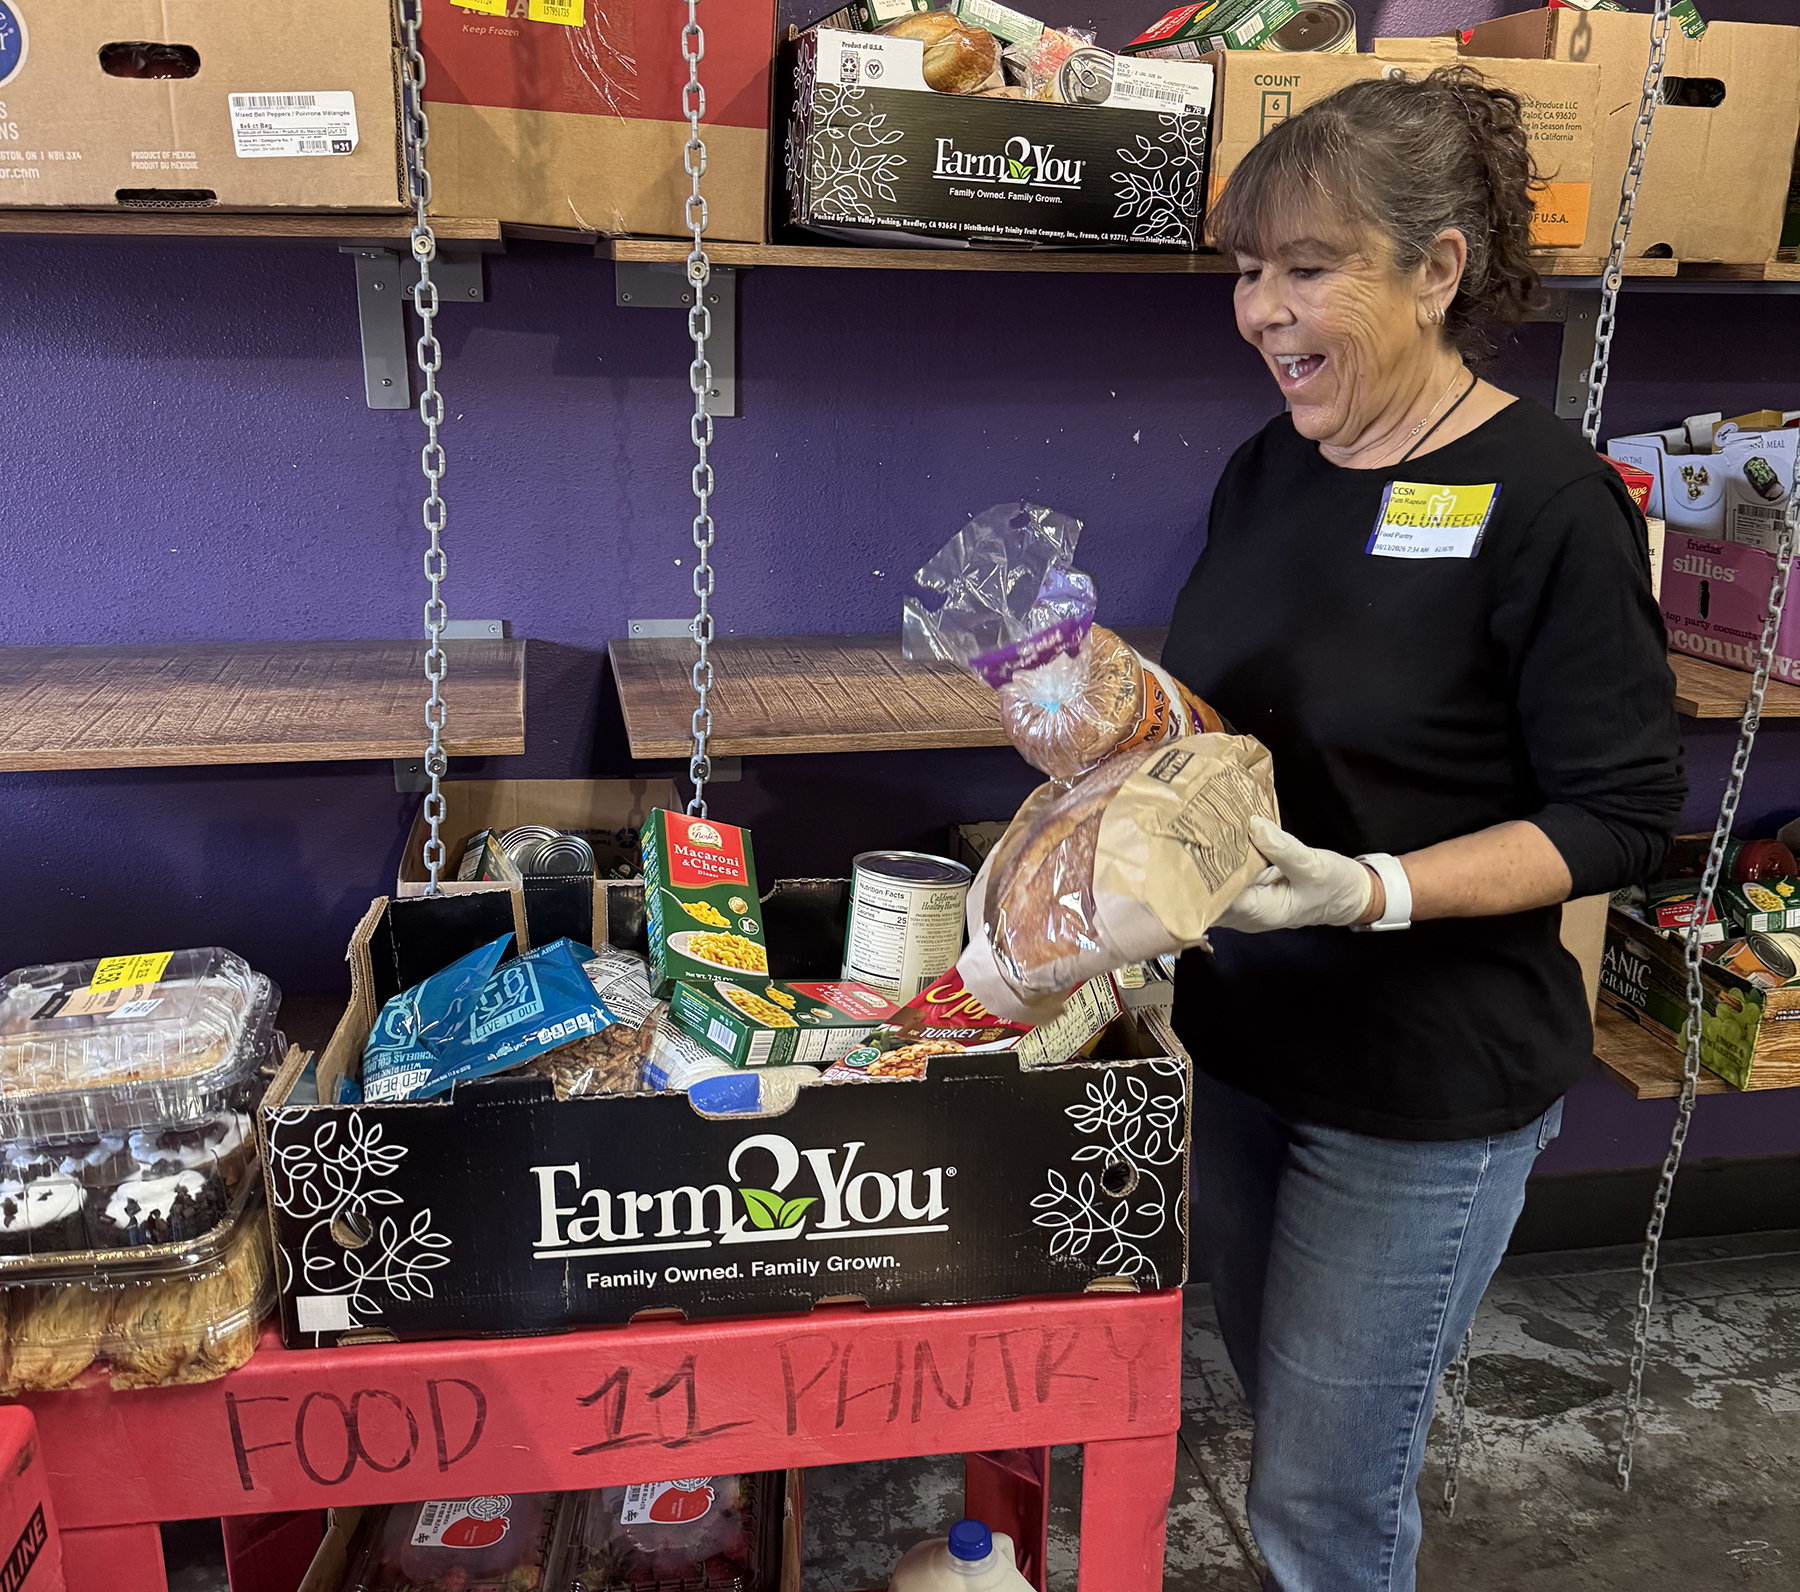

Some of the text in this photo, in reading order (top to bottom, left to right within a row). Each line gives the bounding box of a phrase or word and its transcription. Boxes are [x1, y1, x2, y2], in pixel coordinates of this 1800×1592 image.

[543, 5, 570, 18] 157951735
[462, 24, 520, 37] Keep Frozen
[841, 41, 862, 50] Product
[869, 43, 885, 51] U.S.A.
[1253, 74, 1301, 87] COUNT
[1271, 99, 1280, 111] 6
[1535, 101, 1578, 110] Produce LLC
[1544, 112, 1555, 120] CA
[1555, 112, 1577, 120] 93620
[259, 122, 273, 130] Bag
[1540, 122, 1564, 130] Season
[1565, 122, 1582, 131] from
[1534, 132, 1540, 141] &
[1541, 132, 1574, 141] California
[340, 142, 350, 152] 31
[26, 151, 37, 161] ON
[66, 152, 83, 161] 3X4
[131, 151, 196, 160] PRODUCT OF MEXICO
[131, 161, 199, 170] PRODUIT DU MEXIQUE
[949, 187, 1063, 204] Family Owned. Family Grown.
[1541, 214, 1569, 224] U.S.A.
[814, 212, 835, 221] Packed
[836, 214, 845, 223] by
[845, 214, 857, 222] Sun
[857, 215, 876, 225] Valley
[877, 216, 902, 227] Packing,
[903, 219, 927, 229] Reedley,
[938, 221, 958, 230] 93654
[964, 223, 996, 233] Distributed
[996, 225, 1004, 234] by
[1005, 226, 1023, 236] Trinity
[1024, 227, 1037, 236] Fruit
[1038, 228, 1066, 238] Company,
[1066, 230, 1078, 239] Inc.,
[1079, 231, 1100, 241] Fresno,
[1101, 232, 1109, 240] CA
[1765, 440, 1786, 450] MEAL
[1629, 456, 1643, 464] TIME
[1392, 486, 1416, 496] CCSN
[1385, 510, 1484, 529] VOLUNTEER
[1379, 530, 1414, 541] Food Pantry
[1672, 554, 1736, 583] sillies
[1684, 616, 1711, 631] party
[1713, 622, 1762, 641] coconuts
[673, 843, 740, 868] Macaroni
[697, 869, 719, 878] Dinner
[859, 882, 905, 900] Nutrition Facts
[896, 916, 907, 925] 25
[541, 940, 565, 956] ARROZ
[1602, 945, 1652, 991] ANIC
[1600, 969, 1647, 1008] GRAPES
[474, 1002, 538, 1039] LIVE IT OUT
[919, 1027, 983, 1039] TURKEY
[400, 1062, 422, 1072] WITH
[402, 1070, 428, 1089] RED
[586, 1253, 902, 1290] Family Owned. Family Grown.
[226, 1321, 1153, 1492] FOOD 11 PANTRY
